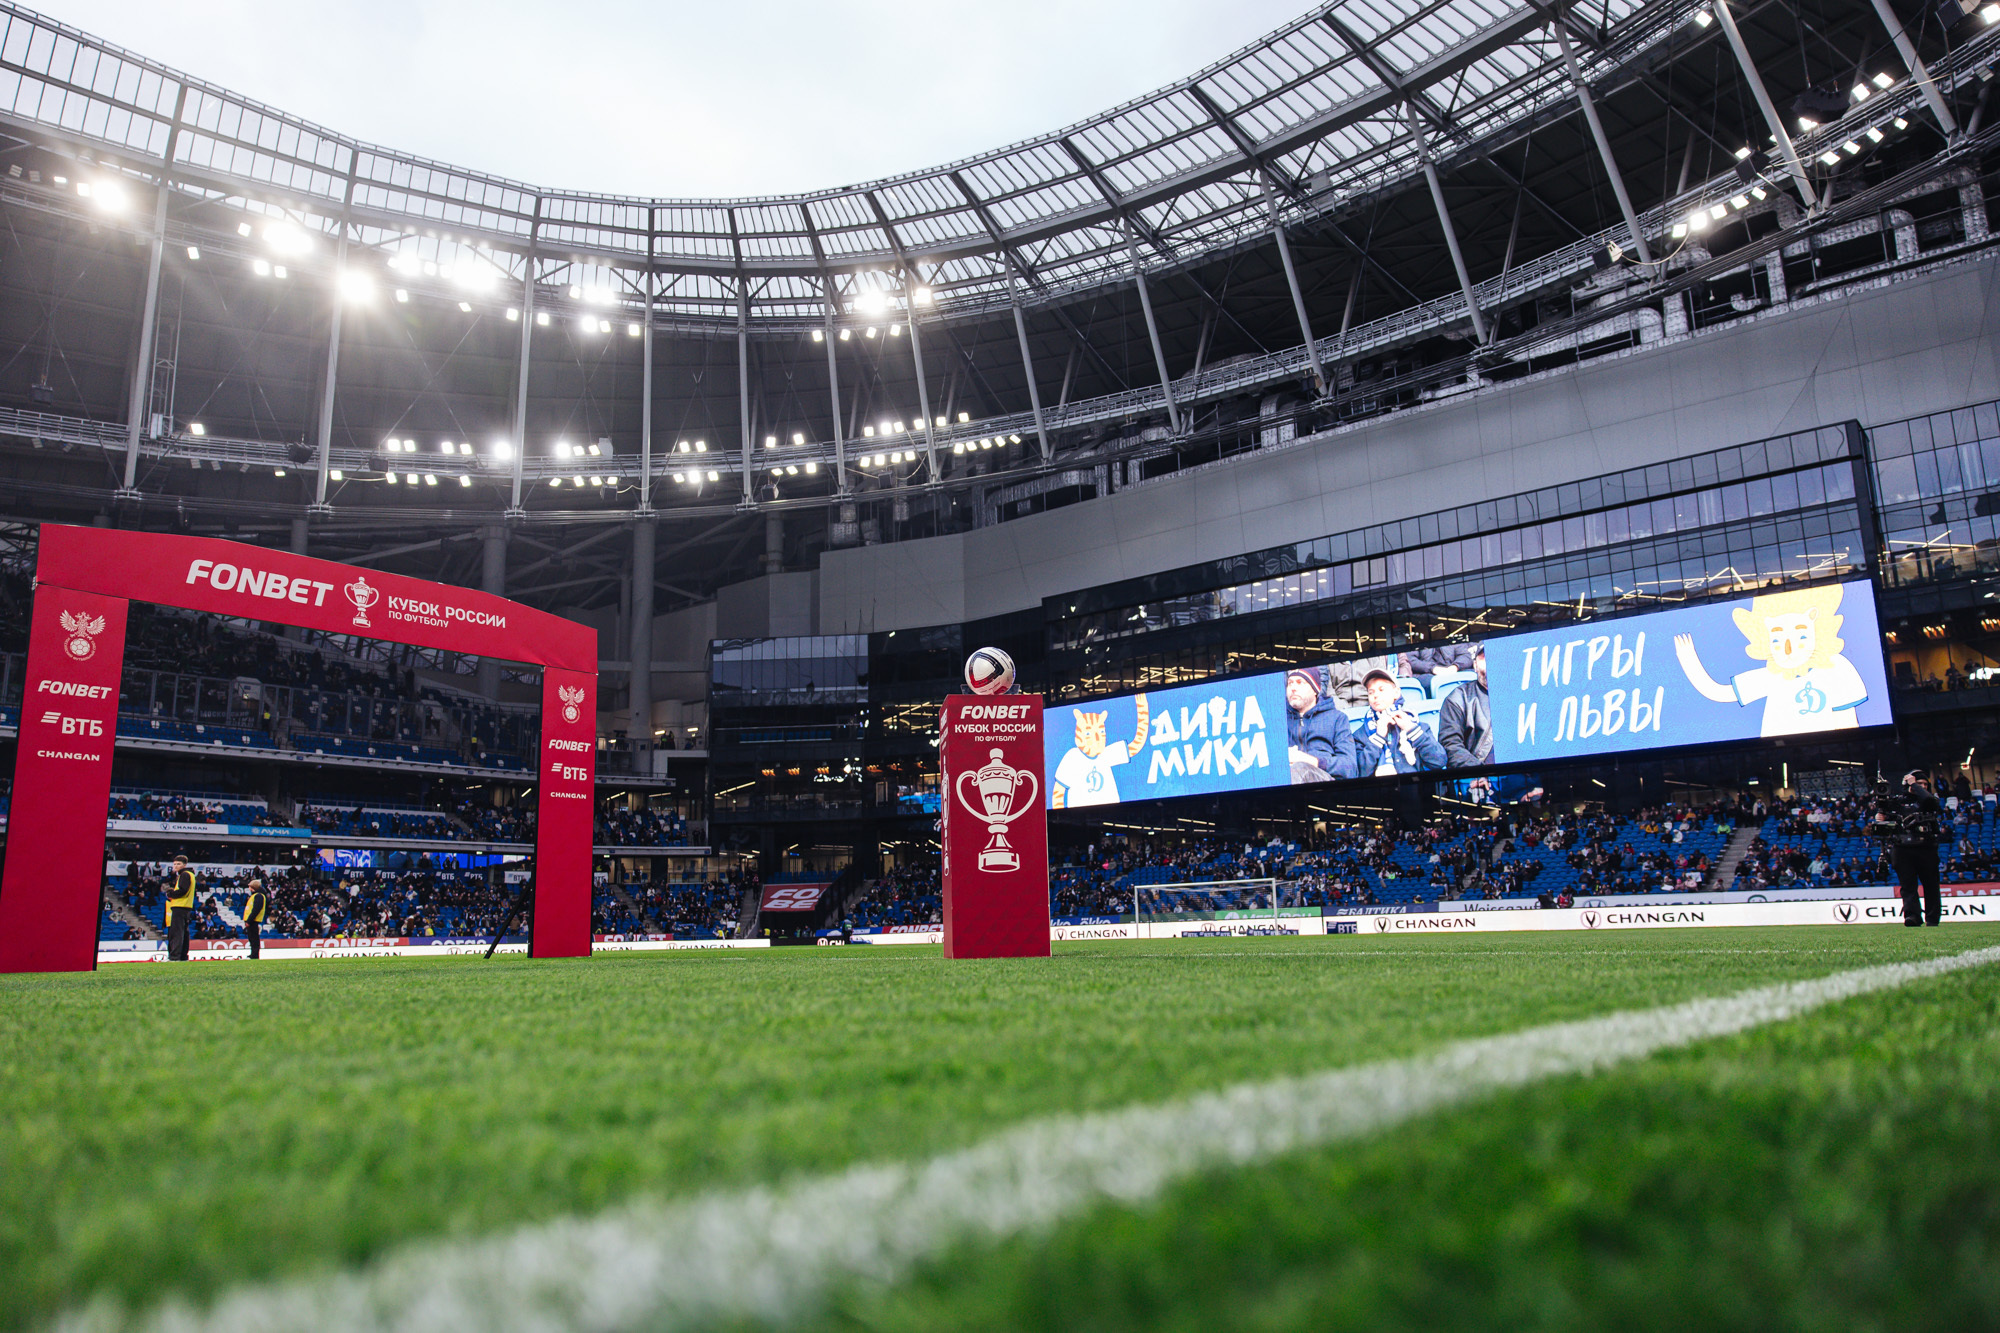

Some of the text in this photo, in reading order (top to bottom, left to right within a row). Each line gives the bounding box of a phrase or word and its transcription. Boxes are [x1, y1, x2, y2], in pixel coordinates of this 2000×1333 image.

[186, 559, 334, 607] FONBET
[388, 595, 506, 629] КУБОК РОССИИ
[388, 610, 449, 628] ПО ФУТБОЛУ
[1521, 631, 1646, 691] ТИГРЫ
[37, 679, 112, 700] FONBET
[960, 704, 1031, 719] FONBET
[1516, 685, 1665, 745] И ЛЬВЫ
[61, 717, 103, 737] ВТБ
[1149, 695, 1266, 746] ДИНА
[955, 723, 1036, 734] КУБОК РОССИИ
[548, 739, 591, 752] FONBET
[37, 750, 100, 761] CHANGAN
[1147, 732, 1270, 784] МИКИ
[563, 766, 587, 781] ВТБ
[550, 792, 587, 800] CHANGAN
[769, 888, 827, 900] FO
[1348, 906, 1407, 916] БАЛТИКА
[1607, 912, 1705, 924] CHANGAN
[1865, 904, 1986, 918] CHGAN
[1337, 924, 1358, 934] ВТБ
[1396, 918, 1476, 929] CHANGAN
[1070, 929, 1127, 939] CHANGAN
